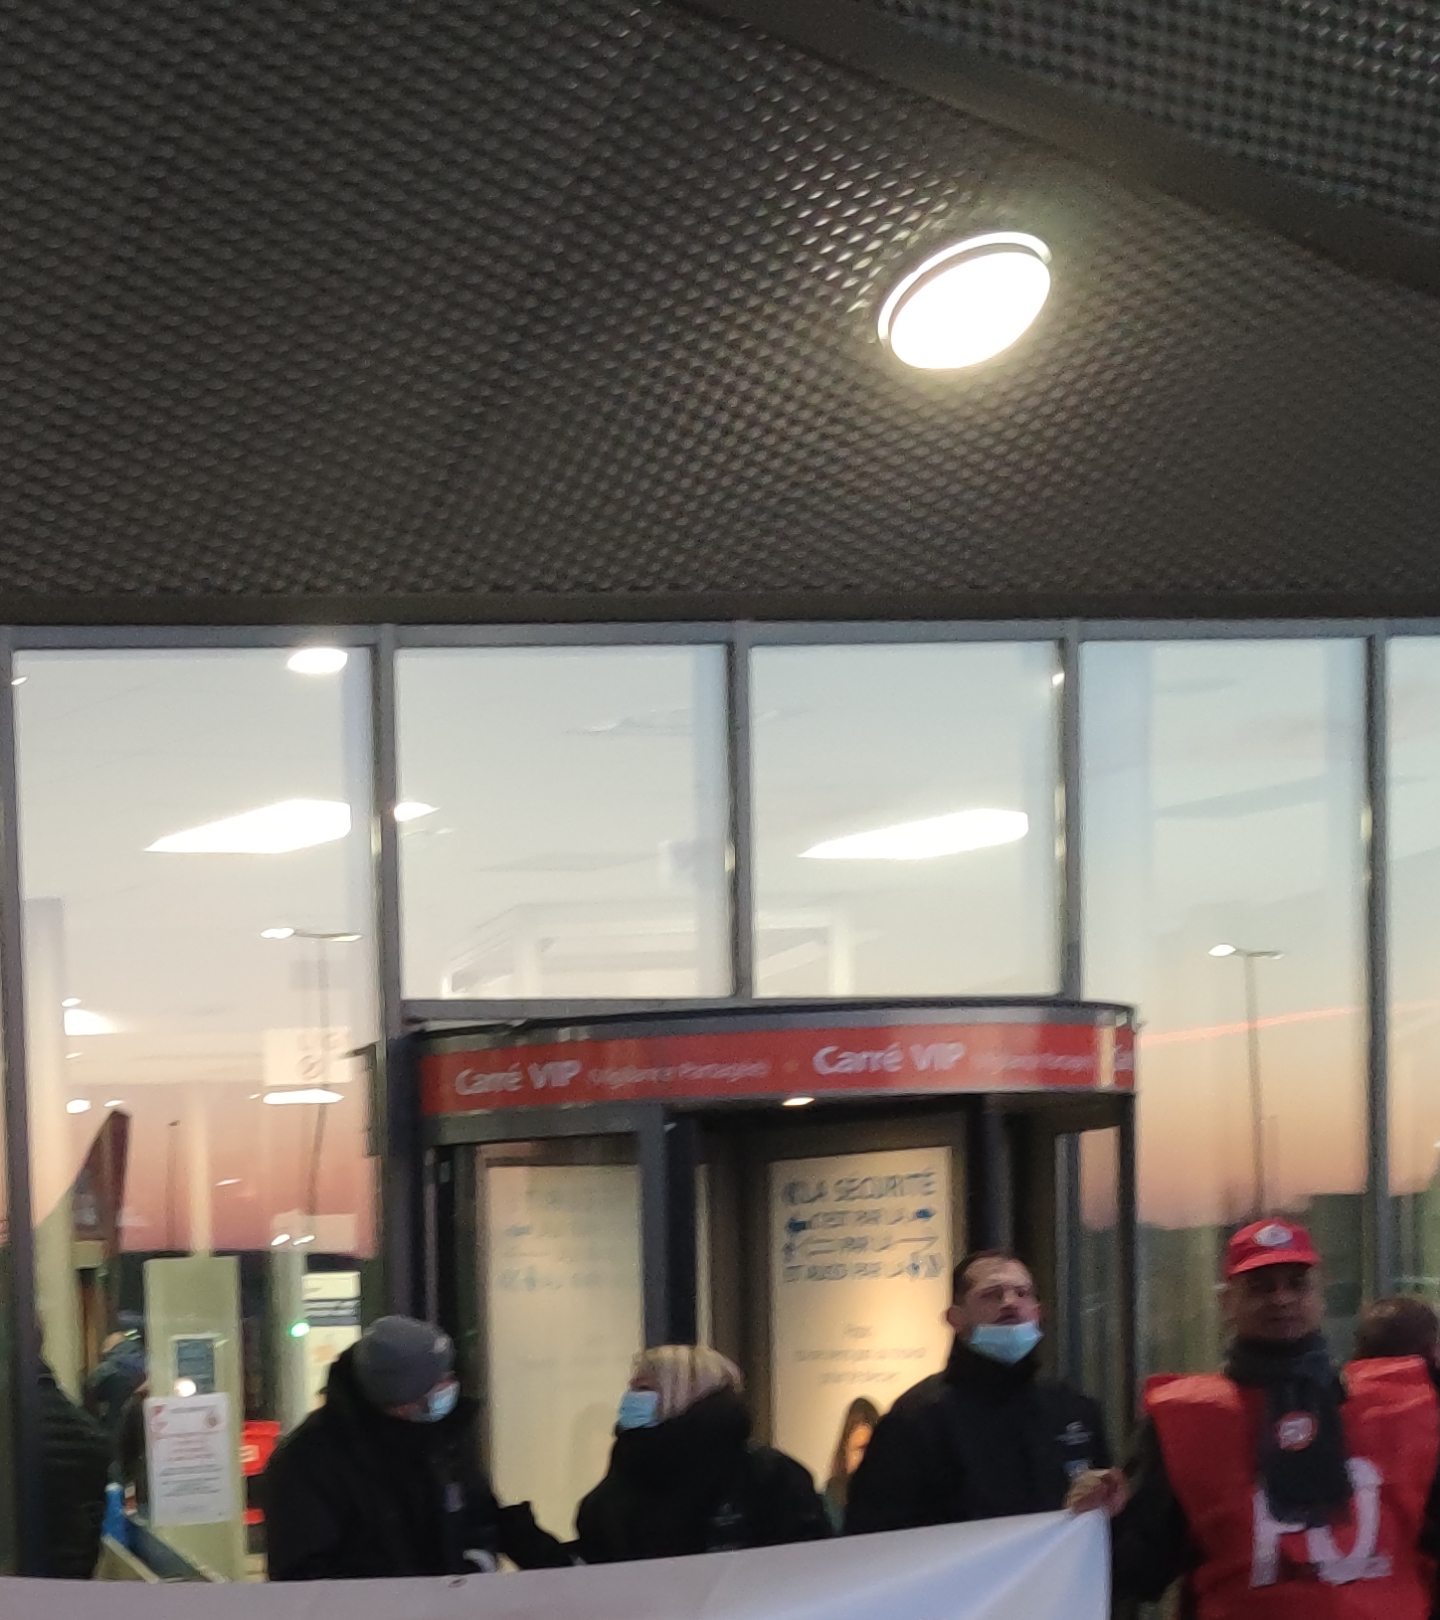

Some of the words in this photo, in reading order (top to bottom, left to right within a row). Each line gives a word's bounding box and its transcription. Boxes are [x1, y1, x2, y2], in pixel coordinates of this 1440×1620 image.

[456, 1062, 523, 1095] Carré
[528, 1059, 582, 1089] VIP
[812, 1043, 906, 1075] Carré
[910, 1042, 966, 1070] VIP
[834, 1167, 937, 1202] SÉCURITÉ
